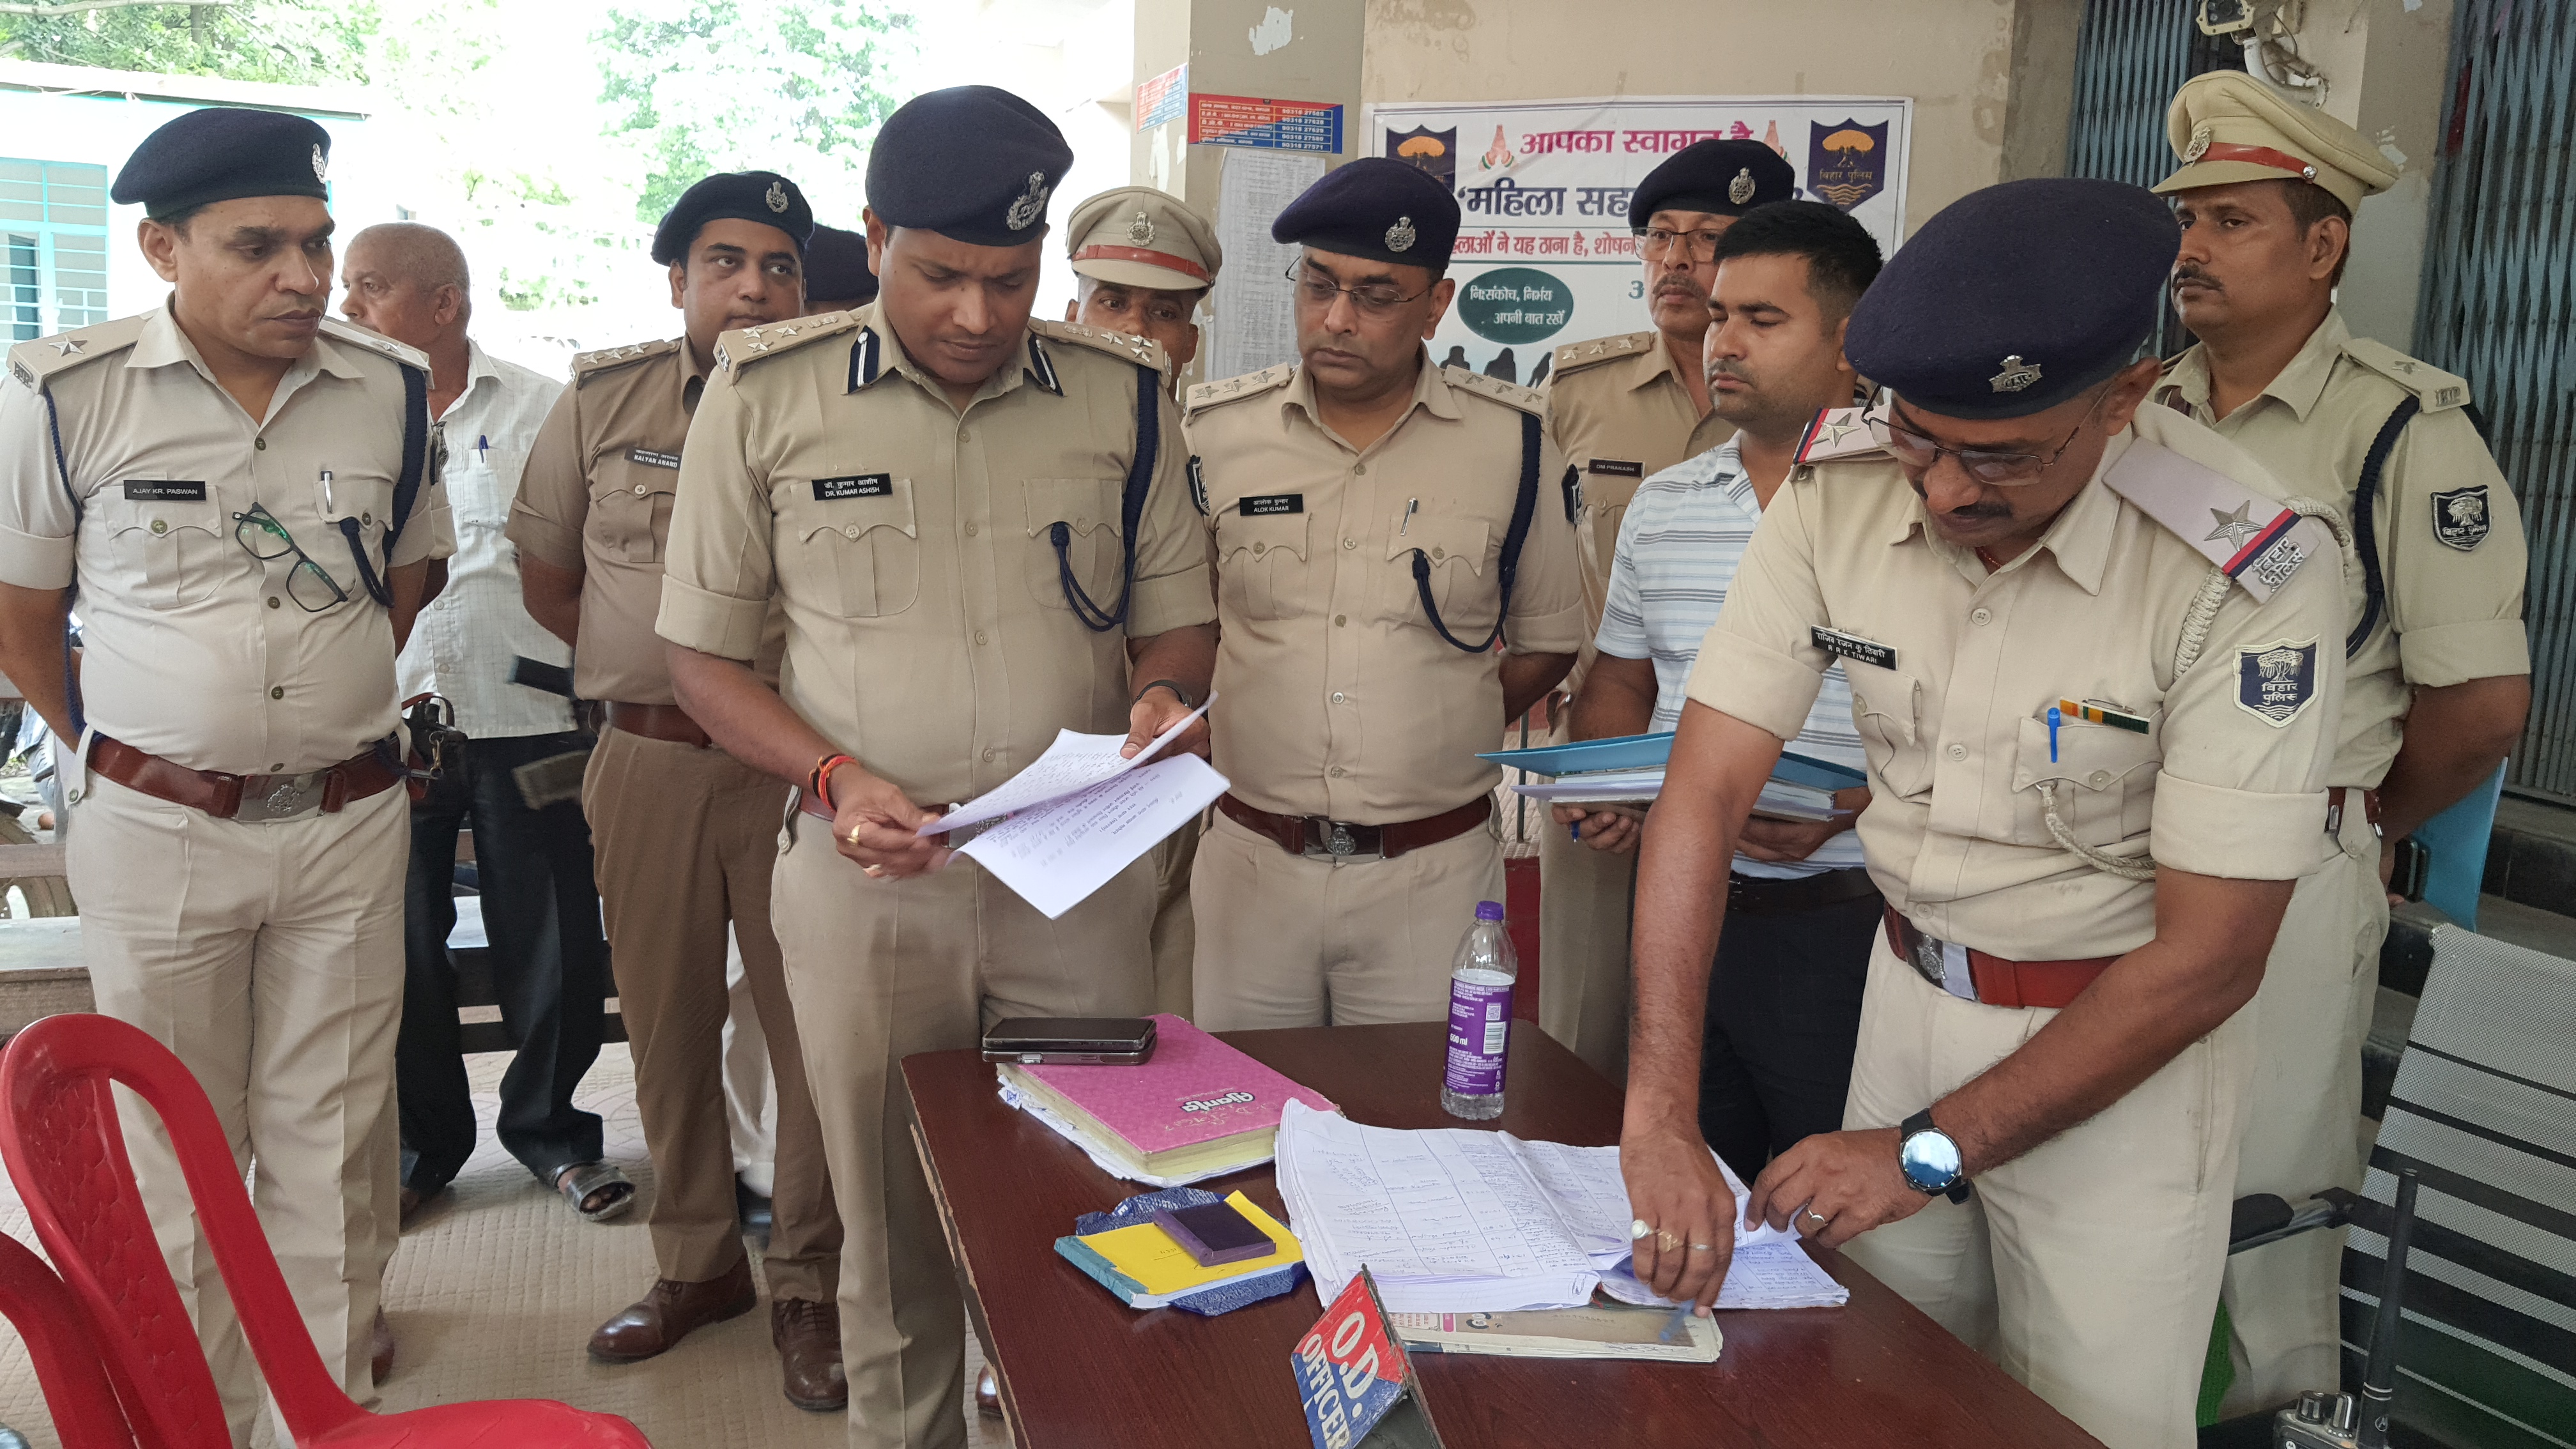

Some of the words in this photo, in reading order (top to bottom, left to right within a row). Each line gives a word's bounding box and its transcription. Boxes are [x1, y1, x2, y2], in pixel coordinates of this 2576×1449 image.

[1520, 130, 1615, 153] आपका
[1497, 230, 1510, 254] ने
[1514, 236, 1536, 255] यह
[1539, 236, 1570, 254] ठाना
[1493, 309, 1522, 325] अपनी
[836, 488, 857, 496] KUMAR
[1851, 651, 1877, 664] TIWARI
[1301, 1333, 1351, 1449] OFFICER
